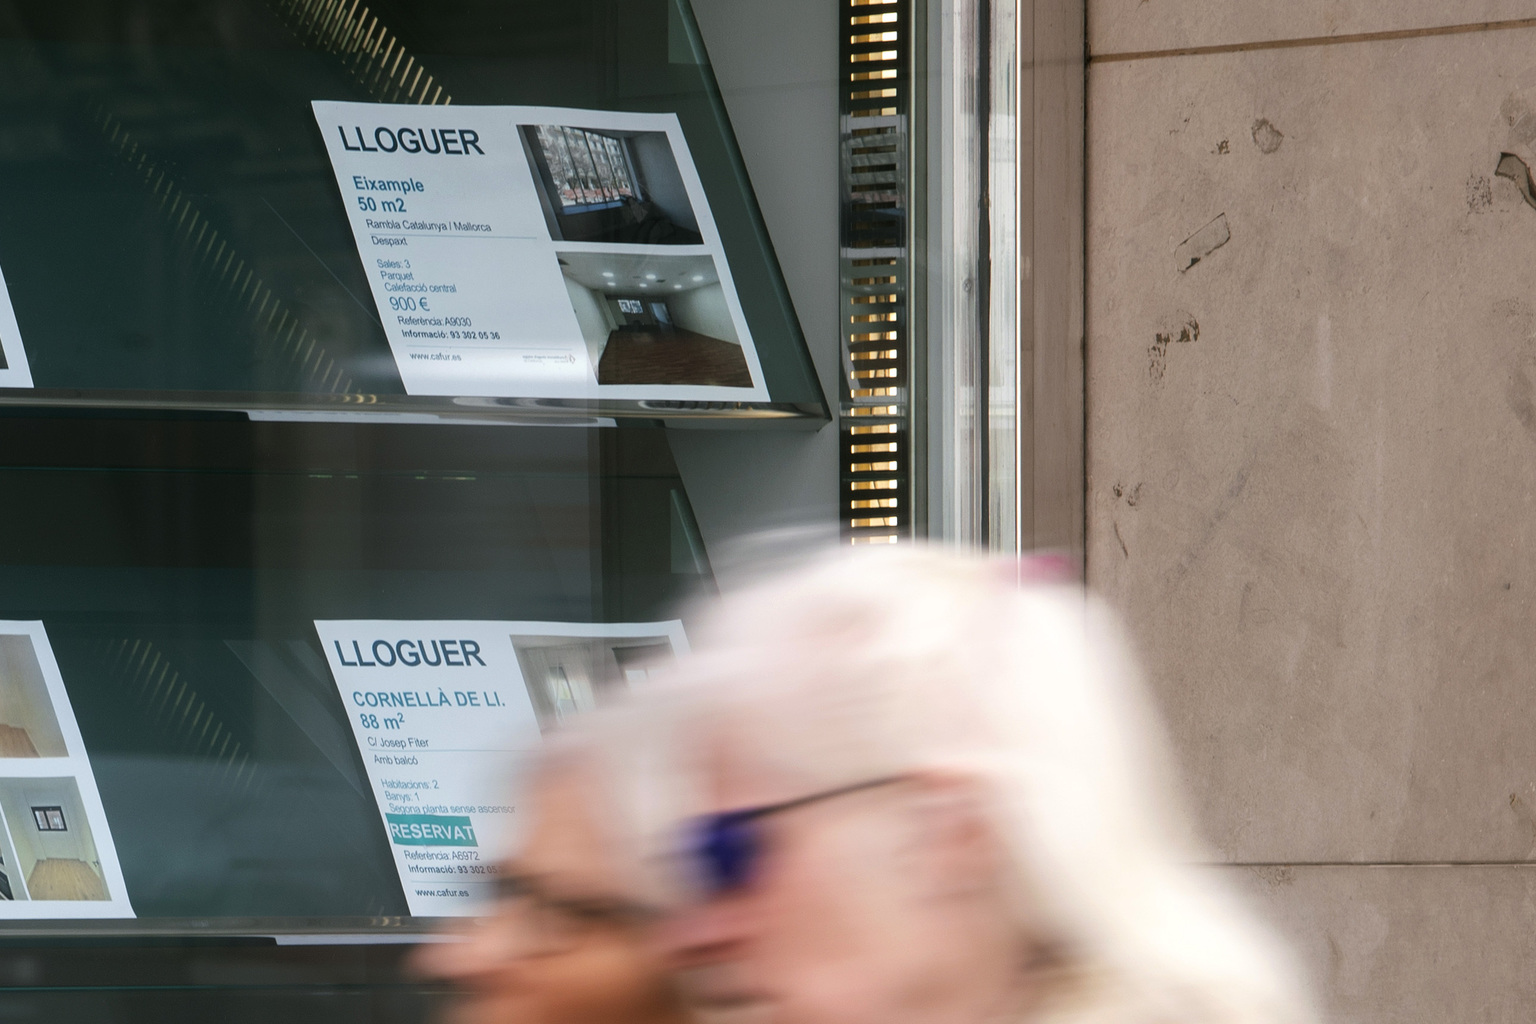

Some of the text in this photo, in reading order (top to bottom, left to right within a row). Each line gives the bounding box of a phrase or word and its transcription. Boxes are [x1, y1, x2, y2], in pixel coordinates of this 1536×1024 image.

[338, 125, 485, 155] LLOGUER
[352, 175, 424, 195] Eixample
[358, 196, 406, 212] 50 m2
[366, 219, 491, 232] Rambla Catalunya Mallorca
[371, 235, 408, 248] Despaxt
[384, 282, 456, 293] Calefacció central
[389, 296, 430, 312] 900 €
[410, 351, 461, 361] www.cafur.es
[334, 640, 486, 667] LLOGUER
[352, 687, 452, 707] CORNELLÀ
[454, 691, 481, 707] DE
[360, 714, 379, 729] 88
[368, 737, 429, 749] C/ Josep Fiter
[390, 822, 473, 840] RESERVAT
[415, 888, 469, 897] www.cafur.es
